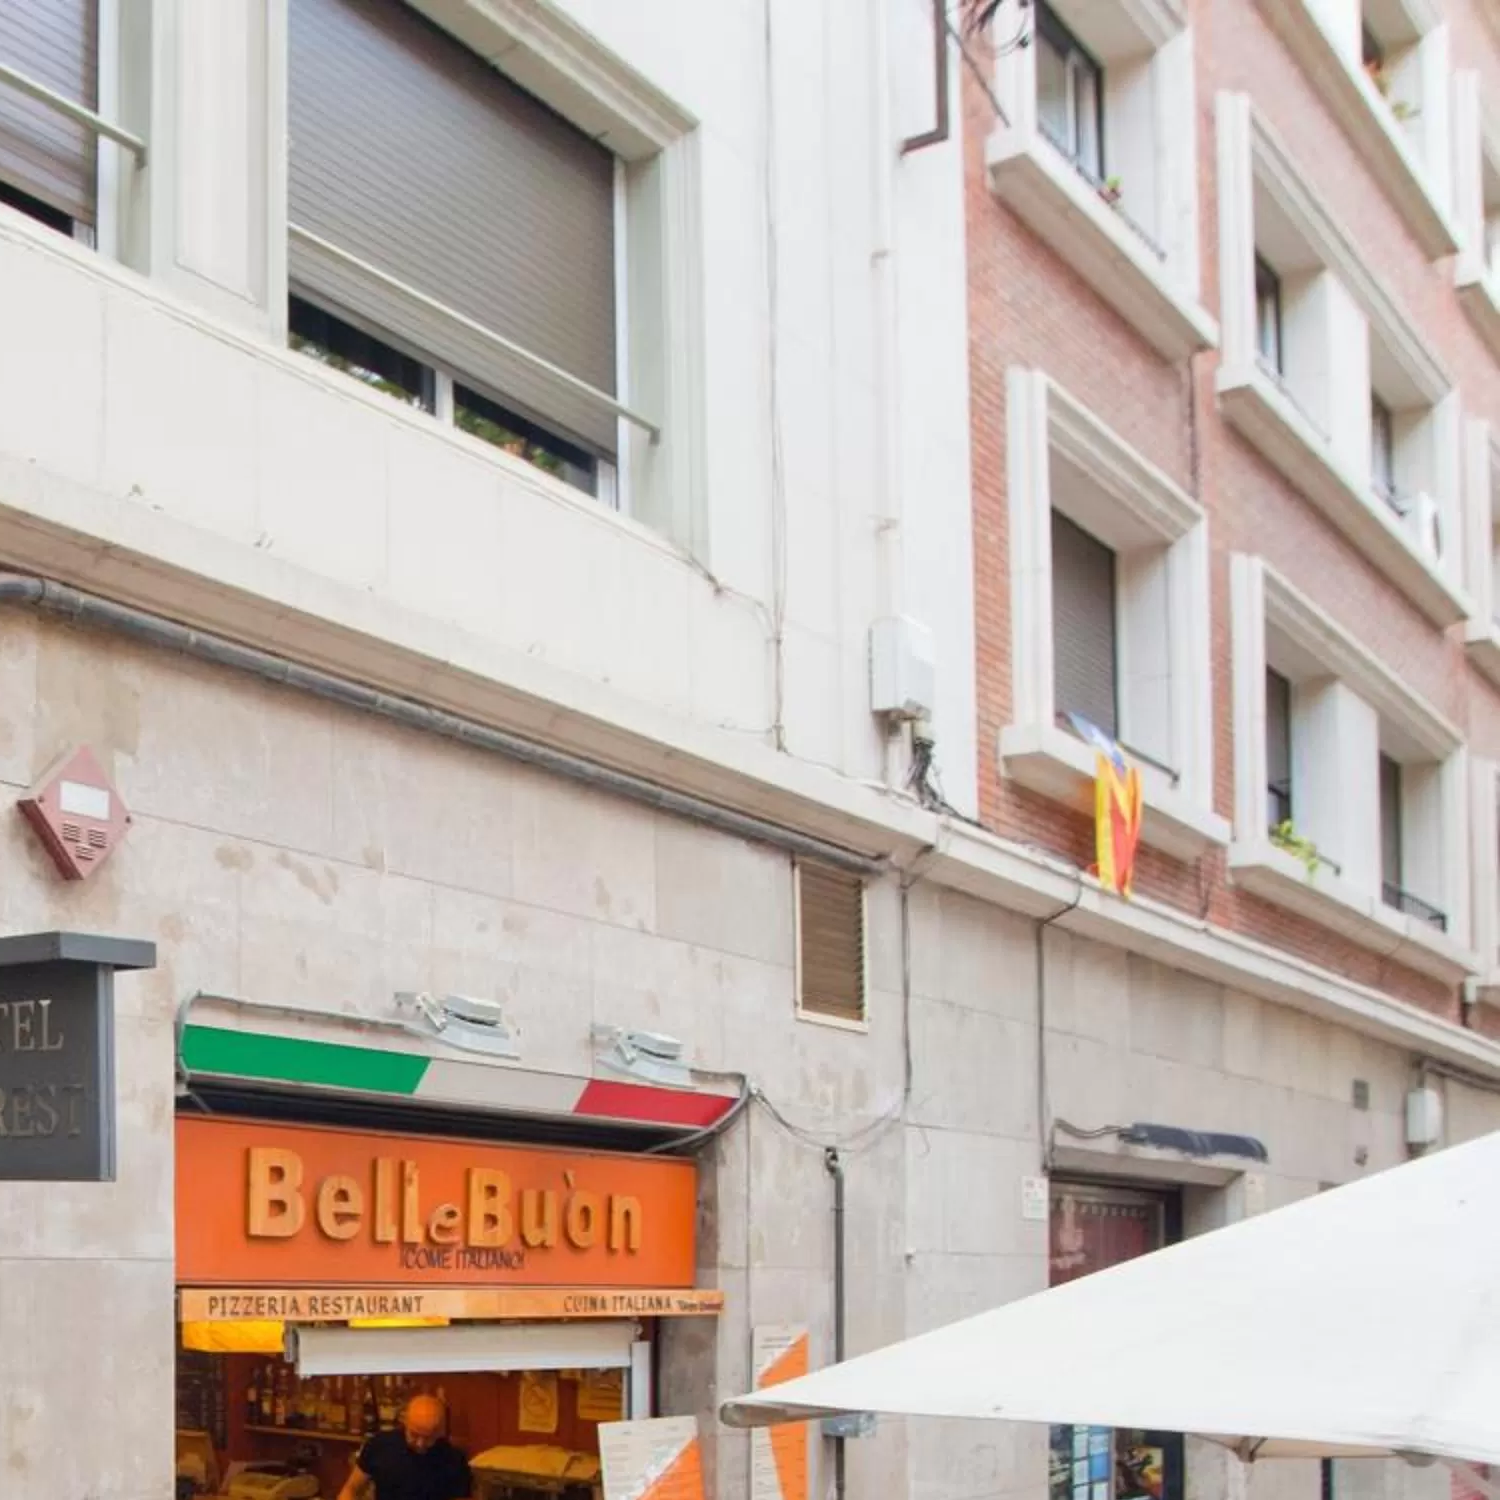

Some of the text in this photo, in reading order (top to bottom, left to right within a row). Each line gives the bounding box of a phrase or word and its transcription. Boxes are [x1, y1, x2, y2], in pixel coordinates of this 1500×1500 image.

[207, 1294, 302, 1317] PIZZERIA
[308, 1294, 425, 1316] RESTAURANT
[563, 1294, 607, 1313] CUINA
[612, 1294, 671, 1313] ITALIANA
